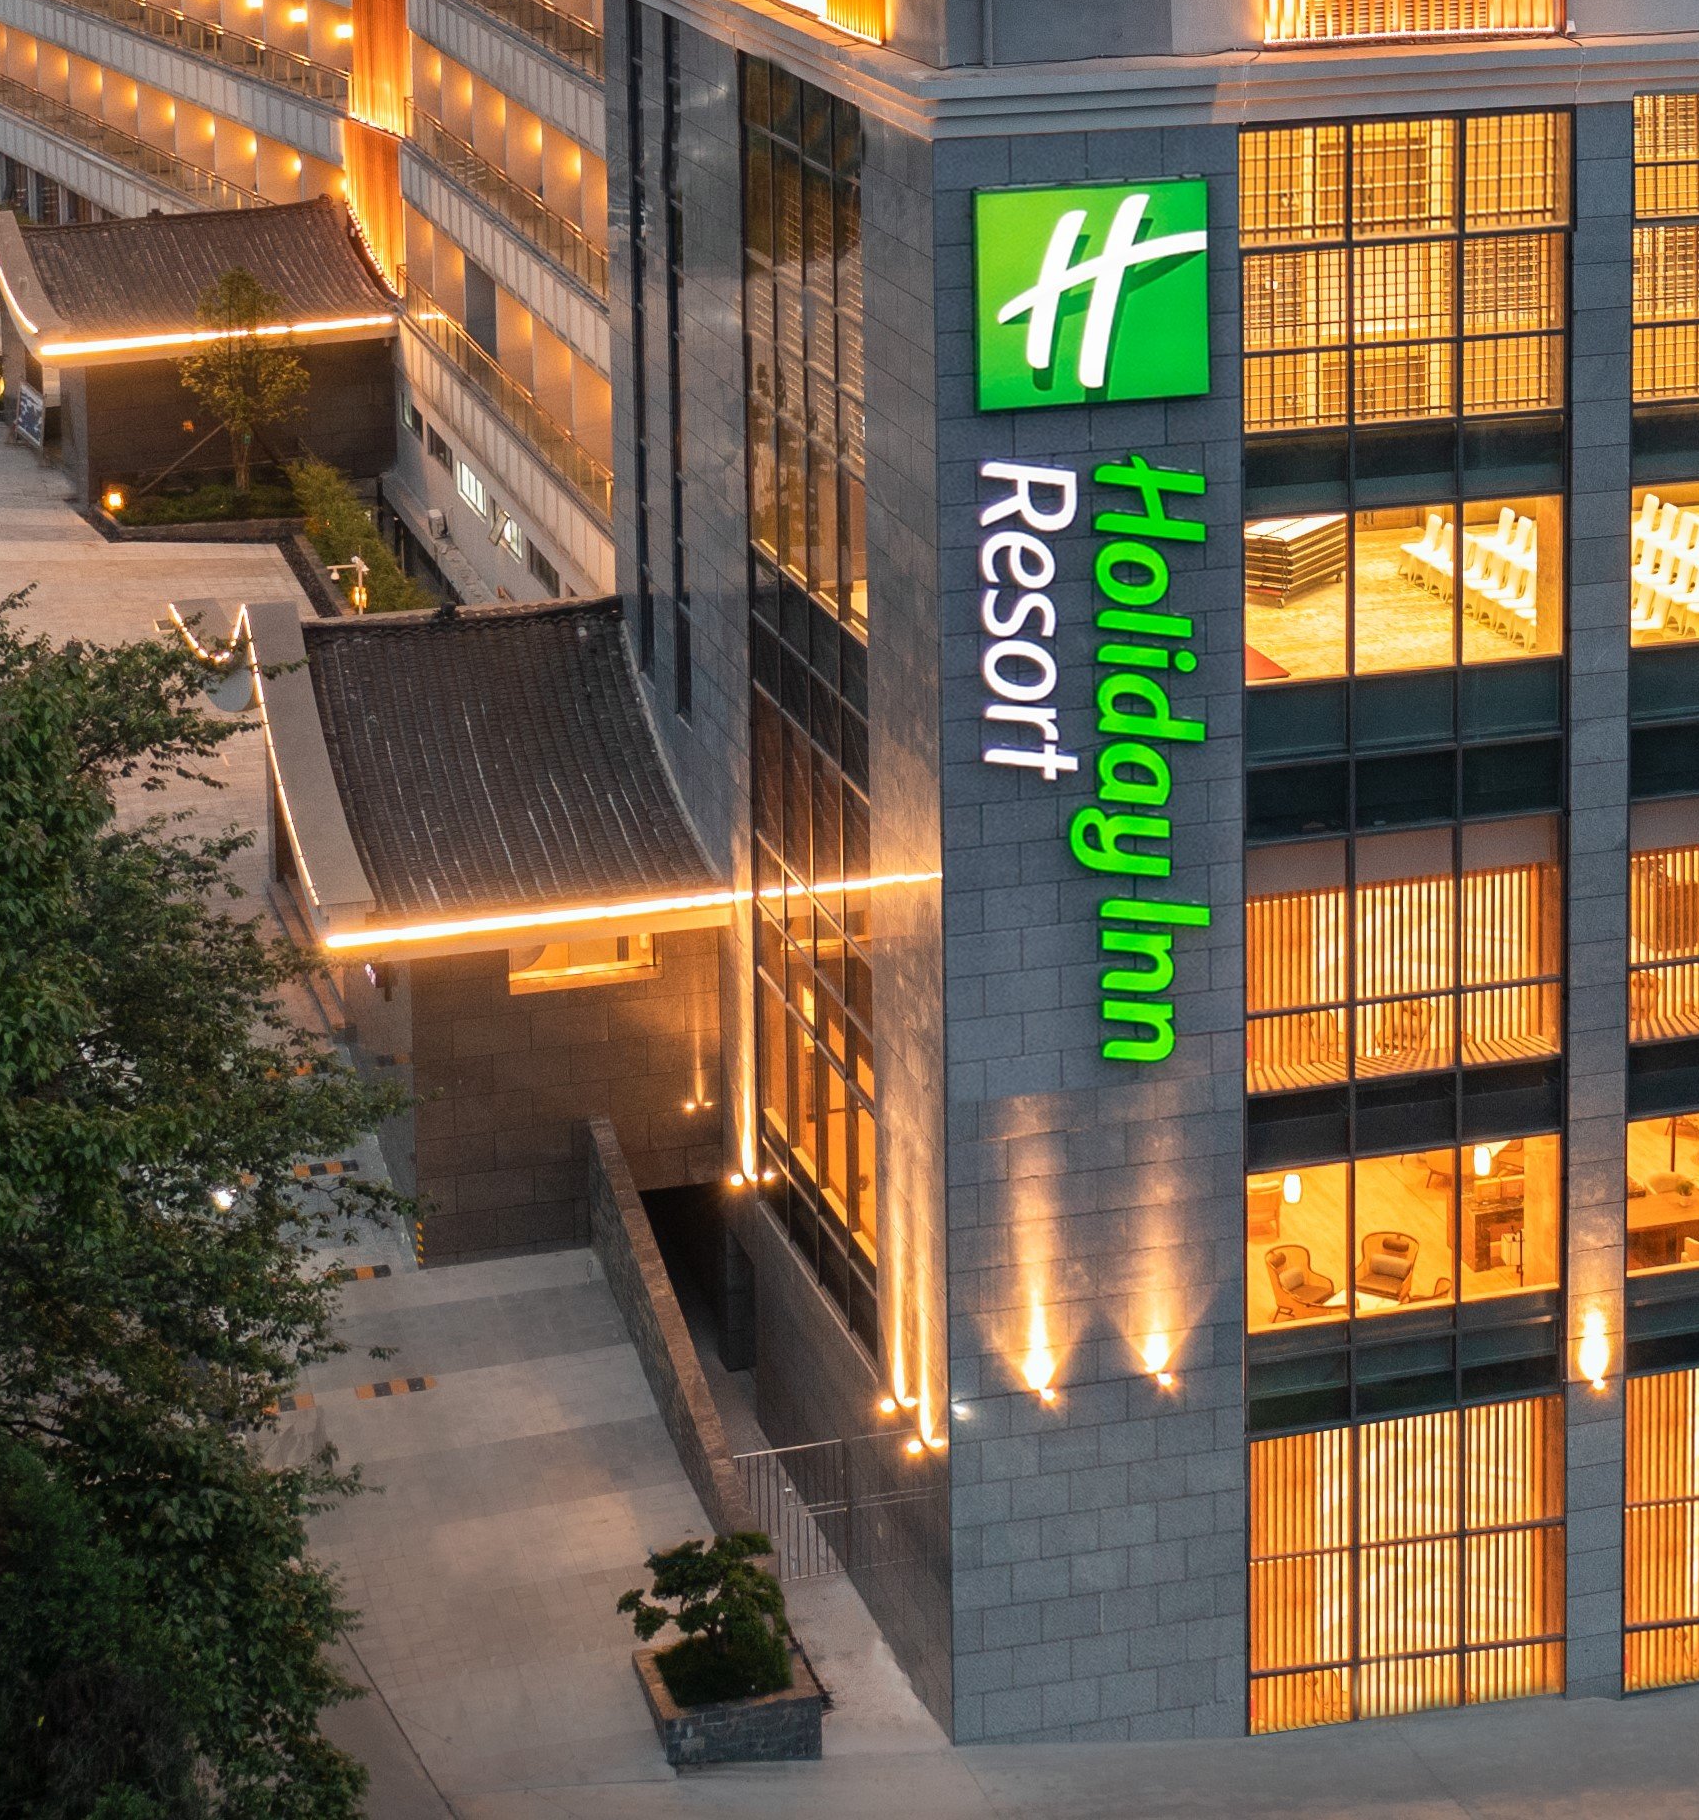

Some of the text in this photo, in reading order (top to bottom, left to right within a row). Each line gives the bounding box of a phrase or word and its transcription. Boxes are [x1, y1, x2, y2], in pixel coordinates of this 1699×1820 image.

[979, 460, 1079, 782] Resort
[1069, 454, 1211, 1064] Holiday Inn
